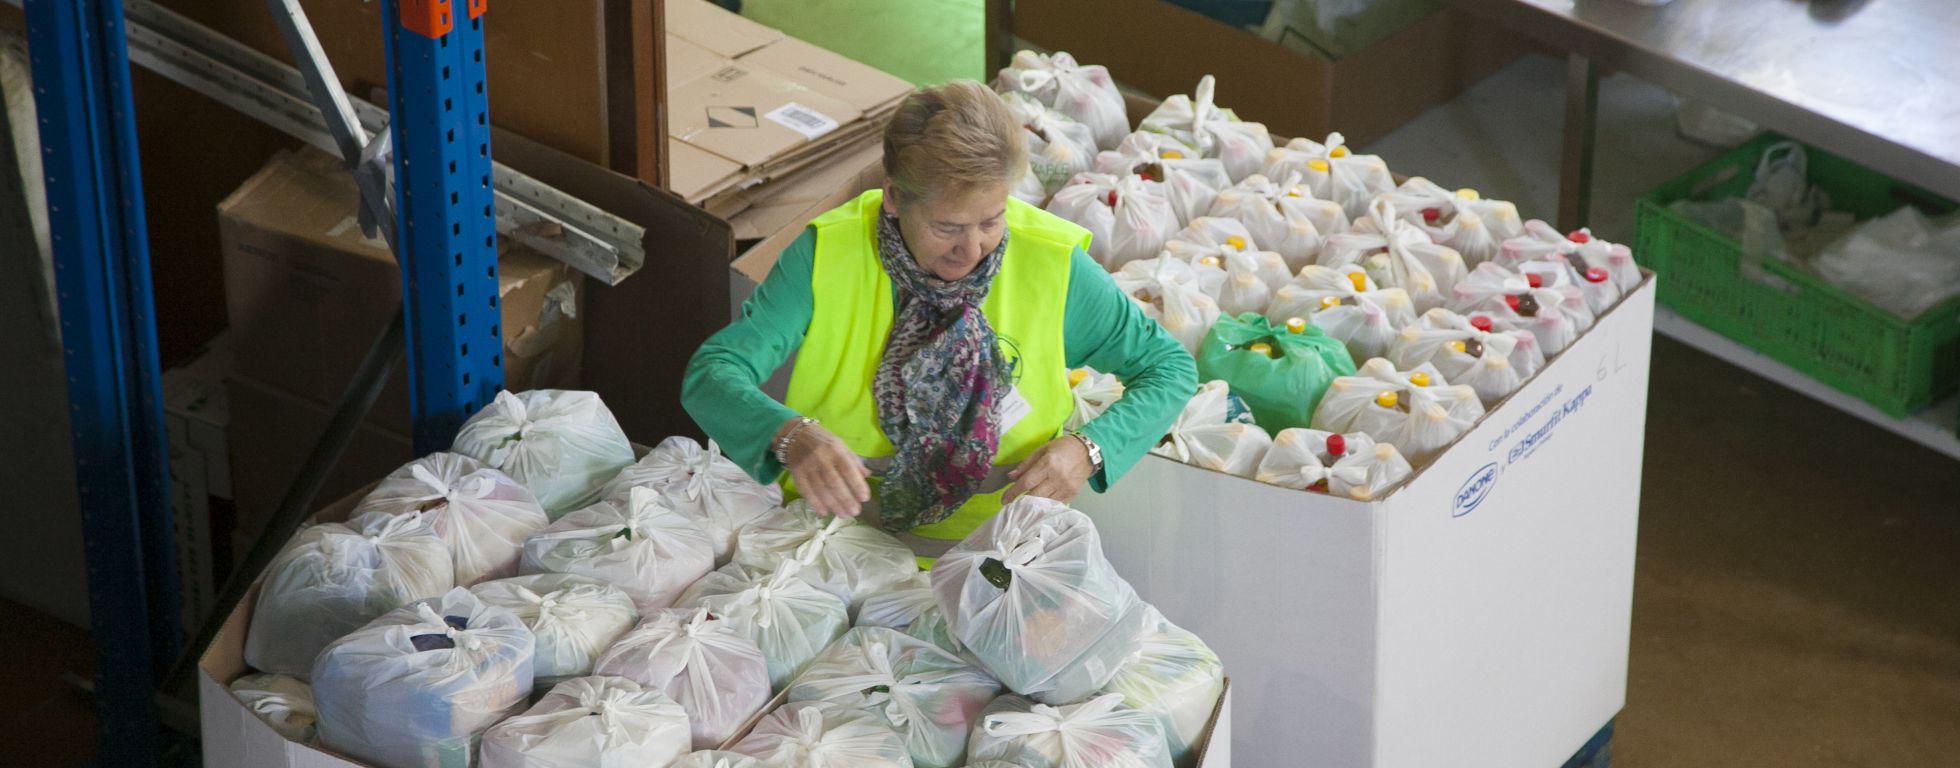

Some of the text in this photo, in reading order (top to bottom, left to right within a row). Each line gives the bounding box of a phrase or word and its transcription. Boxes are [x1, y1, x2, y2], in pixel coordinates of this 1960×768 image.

[1524, 409, 1561, 451] Smurfit
[1562, 384, 1592, 419] Kappa
[1489, 435, 1503, 451] Con
[1457, 469, 1494, 508] DANONE
